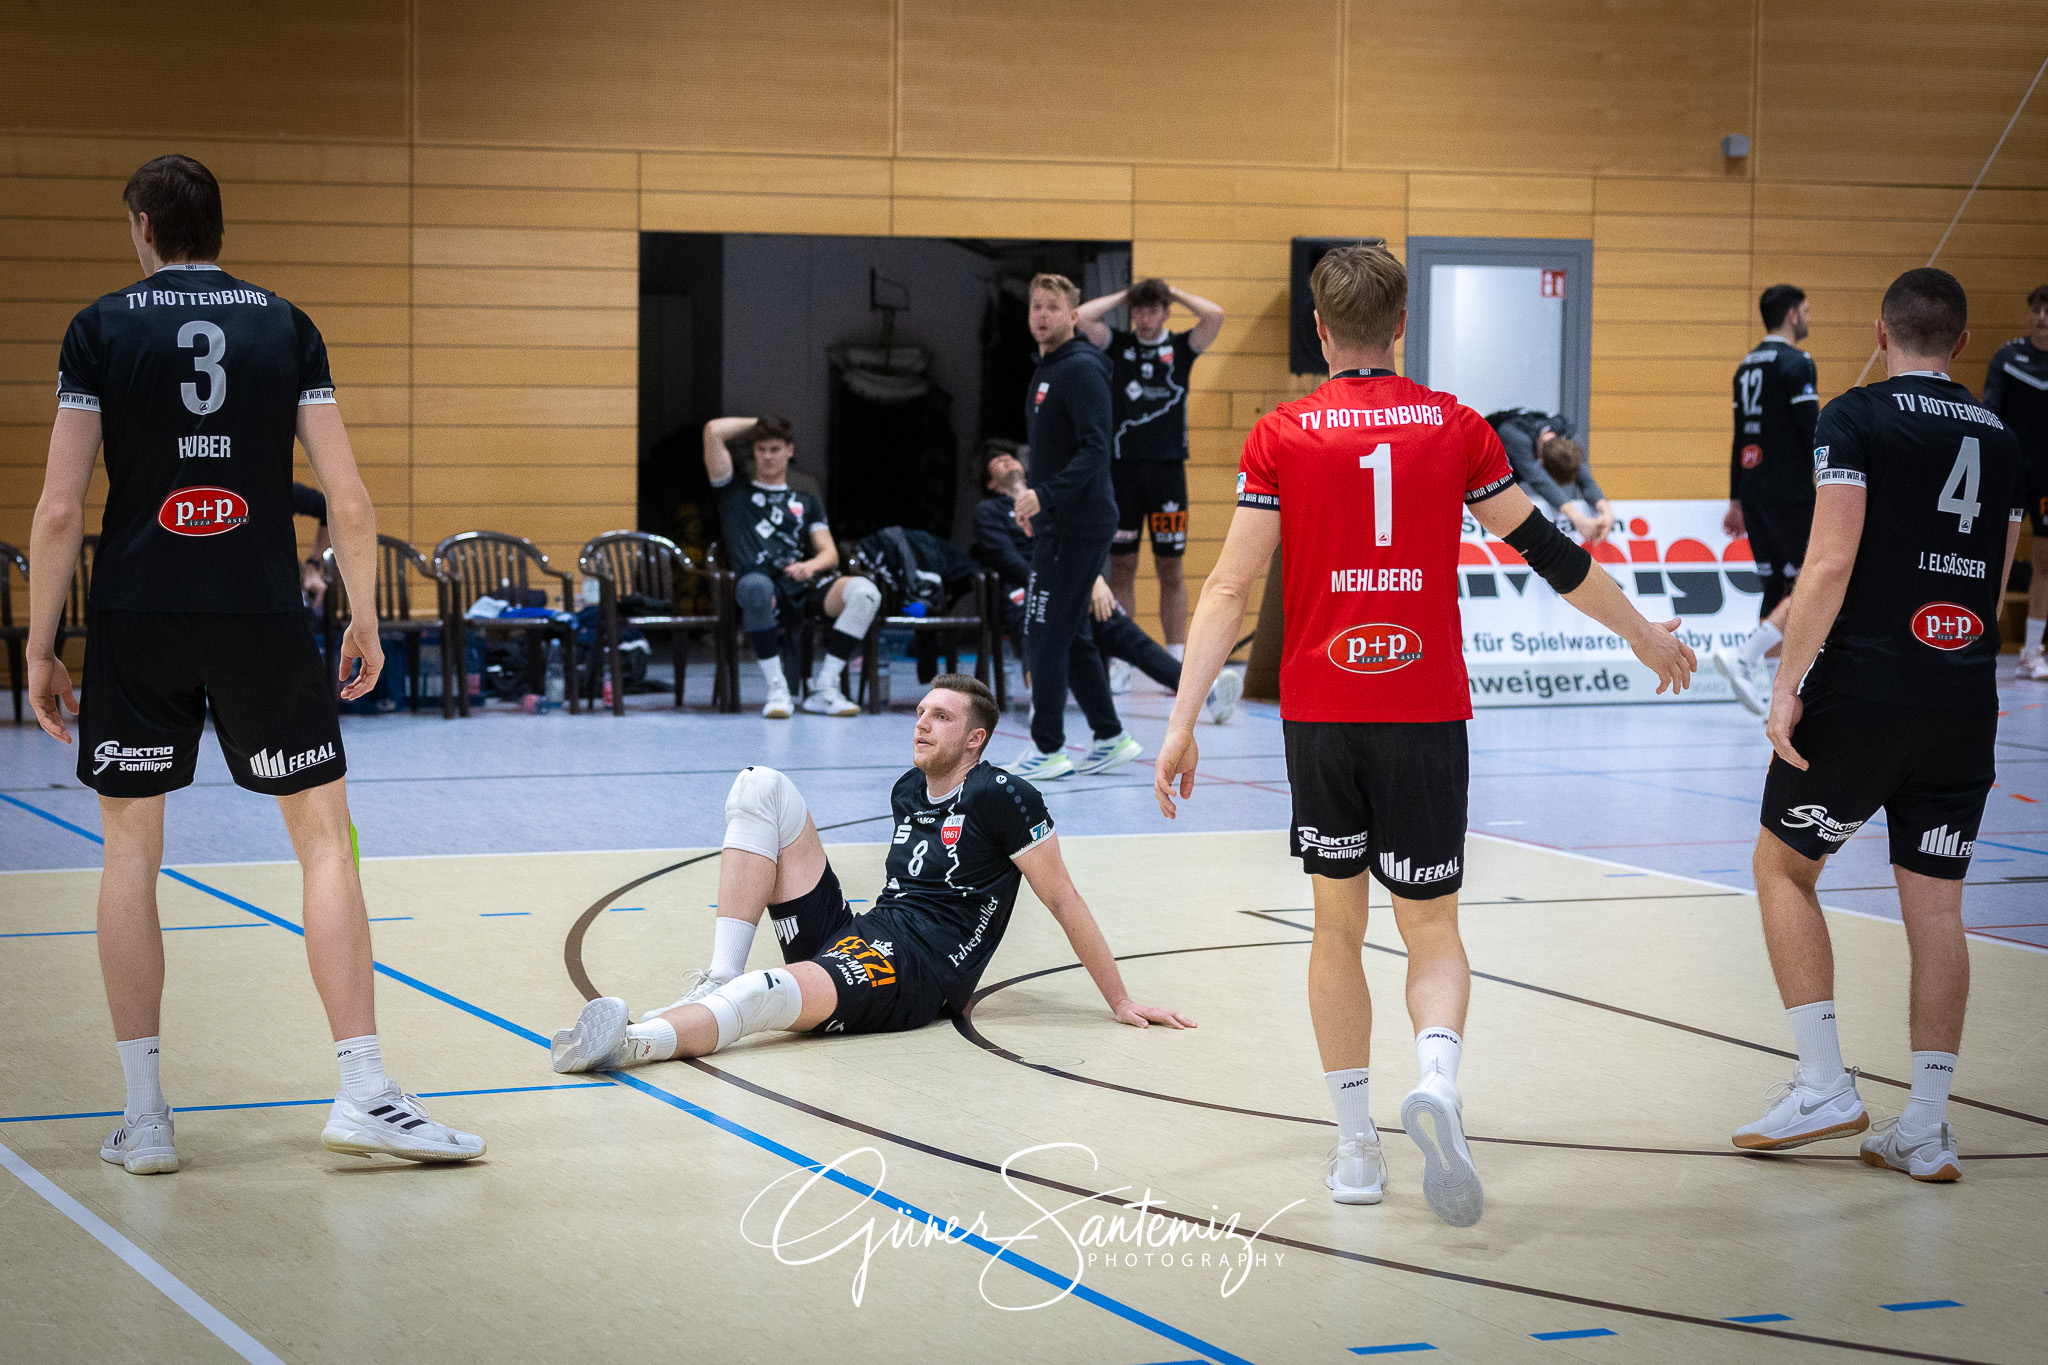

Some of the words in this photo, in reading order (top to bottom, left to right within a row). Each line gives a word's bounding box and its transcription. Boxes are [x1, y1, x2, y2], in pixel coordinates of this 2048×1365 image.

[127, 291, 147, 309] TV
[153, 290, 268, 307] ROTTENBURG
[177, 321, 227, 416] 3
[309, 390, 321, 399] WIR
[1740, 366, 1763, 416] 12
[1300, 411, 1322, 430] TV
[1326, 405, 1443, 429] ROTTENBURG
[1892, 394, 1916, 412] TV
[1918, 394, 2004, 430] ROTTENBURG
[179, 435, 231, 458] HUBER
[1832, 470, 1845, 479] WIR
[1847, 471, 1860, 481] WIR
[1938, 437, 1981, 534] 4
[1258, 495, 1272, 504] WIR
[1359, 443, 1394, 546] 1
[1472, 487, 1487, 499] WIR
[1918, 551, 1926, 570] J.
[1929, 552, 1987, 579] ELSÄSSER
[1331, 568, 1423, 593] MEHLBERG
[1474, 632, 1504, 651] für
[105, 746, 174, 757] ELEKTRO
[289, 742, 336, 773] FERAL
[119, 761, 173, 773] Sanfilippo
[943, 830, 958, 839] 1861
[908, 840, 929, 877] 8
[1413, 856, 1460, 882] FERAL
[836, 963, 854, 986] JAKO
[1821, 1013, 1836, 1021] JA
[1425, 1033, 1458, 1044] JAKO
[1924, 1063, 1954, 1073] JAKO
[1340, 1077, 1369, 1090] JAKO
